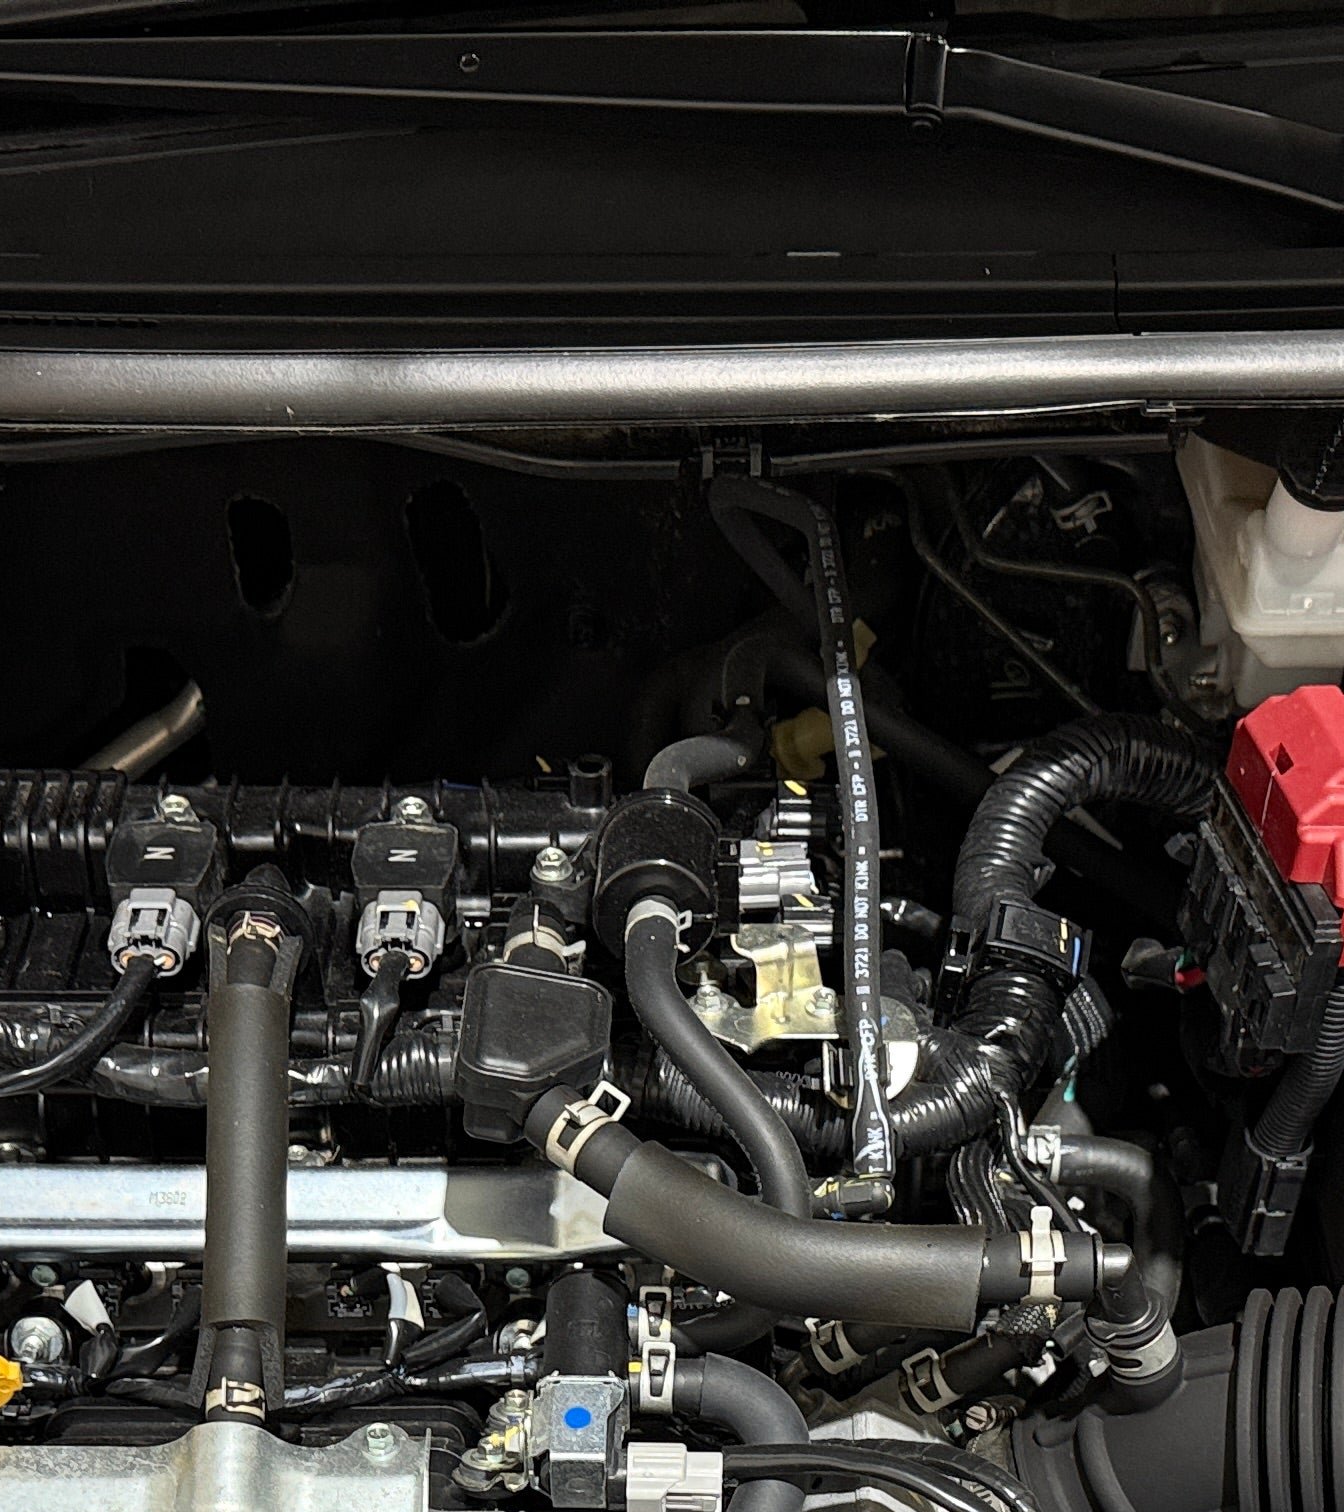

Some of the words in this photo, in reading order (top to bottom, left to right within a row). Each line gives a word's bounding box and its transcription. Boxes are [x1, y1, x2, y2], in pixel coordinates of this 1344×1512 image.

[836, 676, 853, 698] NOT
[840, 699, 855, 715] DO
[842, 719, 861, 746] 3721
[852, 799, 868, 822] DTR
[853, 860, 869, 890] KINK
[854, 895, 868, 918] NOT
[854, 923, 868, 940] DO
[854, 947, 870, 979] 3721
